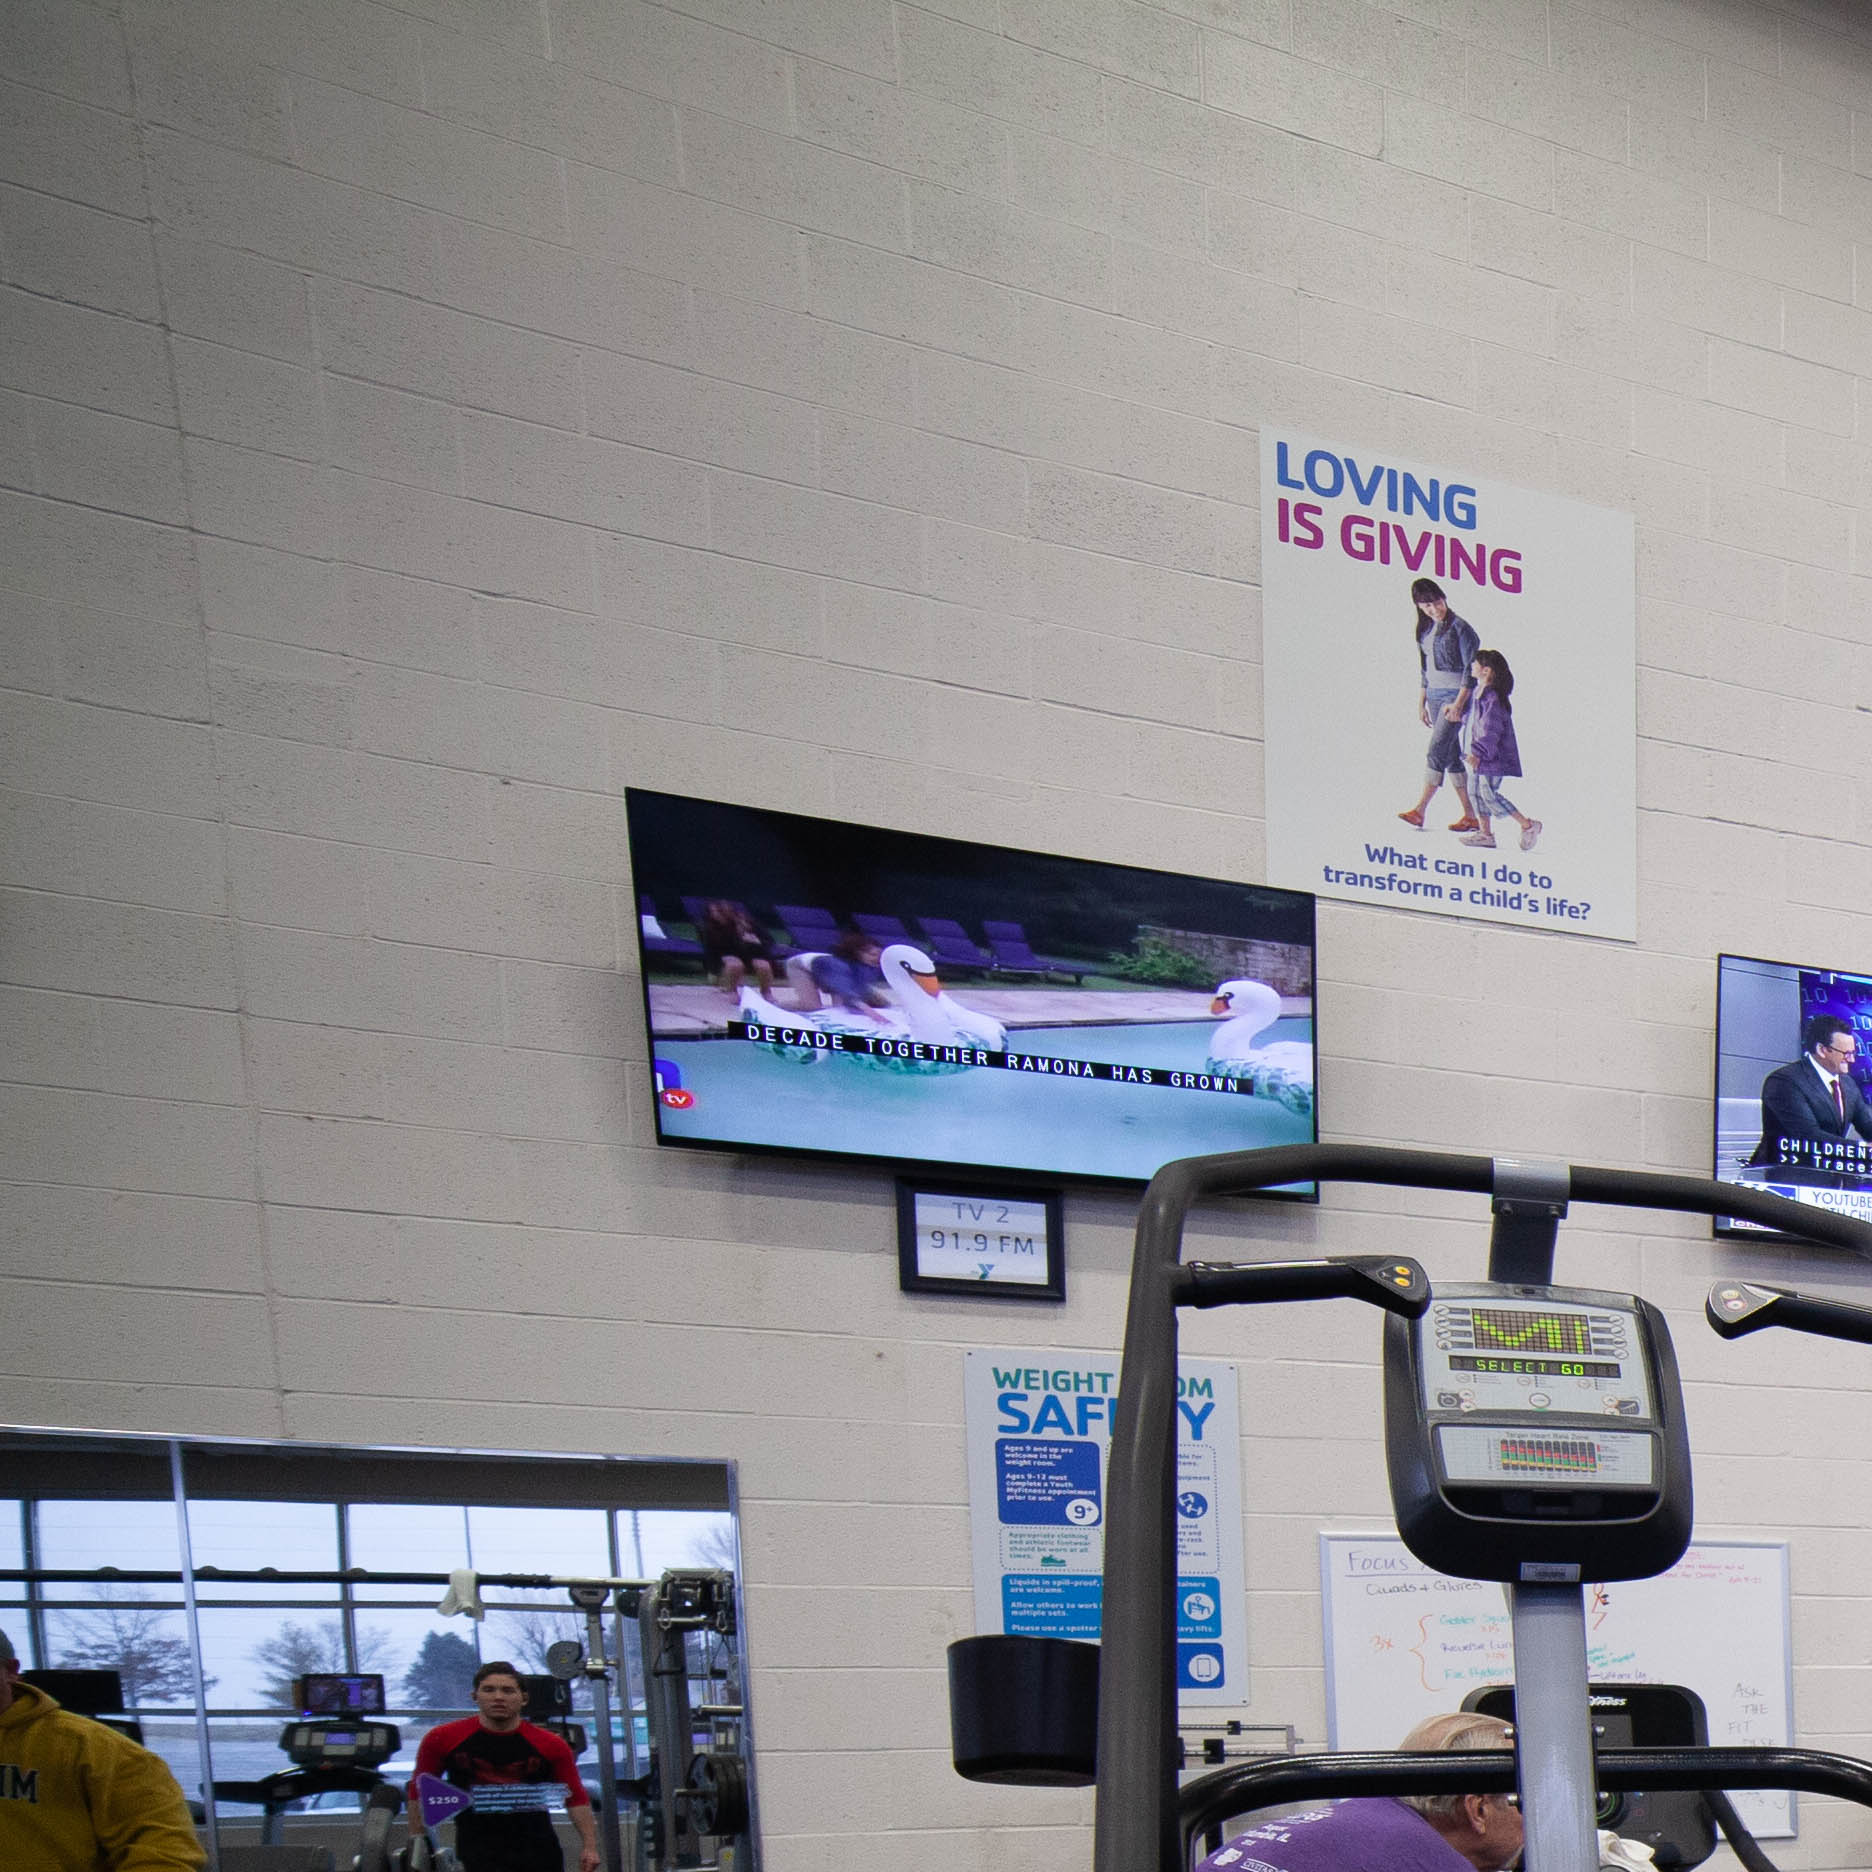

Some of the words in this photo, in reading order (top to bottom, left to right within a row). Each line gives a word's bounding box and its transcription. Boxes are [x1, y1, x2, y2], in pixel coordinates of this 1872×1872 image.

[1276, 441, 1477, 530] LOVING
[1278, 498, 1323, 550] IS
[1341, 515, 1523, 594] GIVING
[1365, 844, 1428, 871] What
[1434, 859, 1474, 878] can
[1481, 863, 1487, 880] I
[1494, 864, 1523, 885] do
[1529, 870, 1552, 889] to
[1324, 866, 1443, 899] transform
[1449, 888, 1463, 901] a
[1469, 888, 1540, 914] child's
[1545, 897, 1591, 921] life?
[747, 1025, 844, 1051] DECADE
[866, 1037, 989, 1067] TOGETHER
[1007, 1054, 1094, 1078] RAMONA
[1112, 1067, 1152, 1084] HAS
[1170, 1072, 1239, 1094] GROWN
[666, 1093, 686, 1105] tv
[952, 1202, 984, 1221] TV
[996, 1206, 1009, 1223] 2
[931, 1230, 989, 1252] 91.9
[1001, 1235, 1034, 1256] FM
[1476, 1359, 1546, 1373] SELECT
[1561, 1364, 1584, 1376] GO
[992, 1367, 1114, 1394] WEIGHT
[1004, 1445, 1024, 1454] Ages
[1005, 1459, 1032, 1467] weight
[1006, 1473, 1025, 1481] Ages
[1006, 1480, 1042, 1488] complete
[1047, 1489, 1096, 1497] appointment
[1006, 1494, 1026, 1502] prior
[1009, 1579, 1041, 1587] Liquids
[1052, 1579, 1100, 1588] spill-proof,
[1011, 1601, 1033, 1609] Allow
[1036, 1601, 1065, 1609] others
[1077, 1601, 1098, 1609] work
[1011, 1609, 1047, 1618] multiple
[1011, 1624, 1040, 1632] Please
[1066, 1624, 1097, 1633] spotter
[428, 1796, 459, 1805] $250
